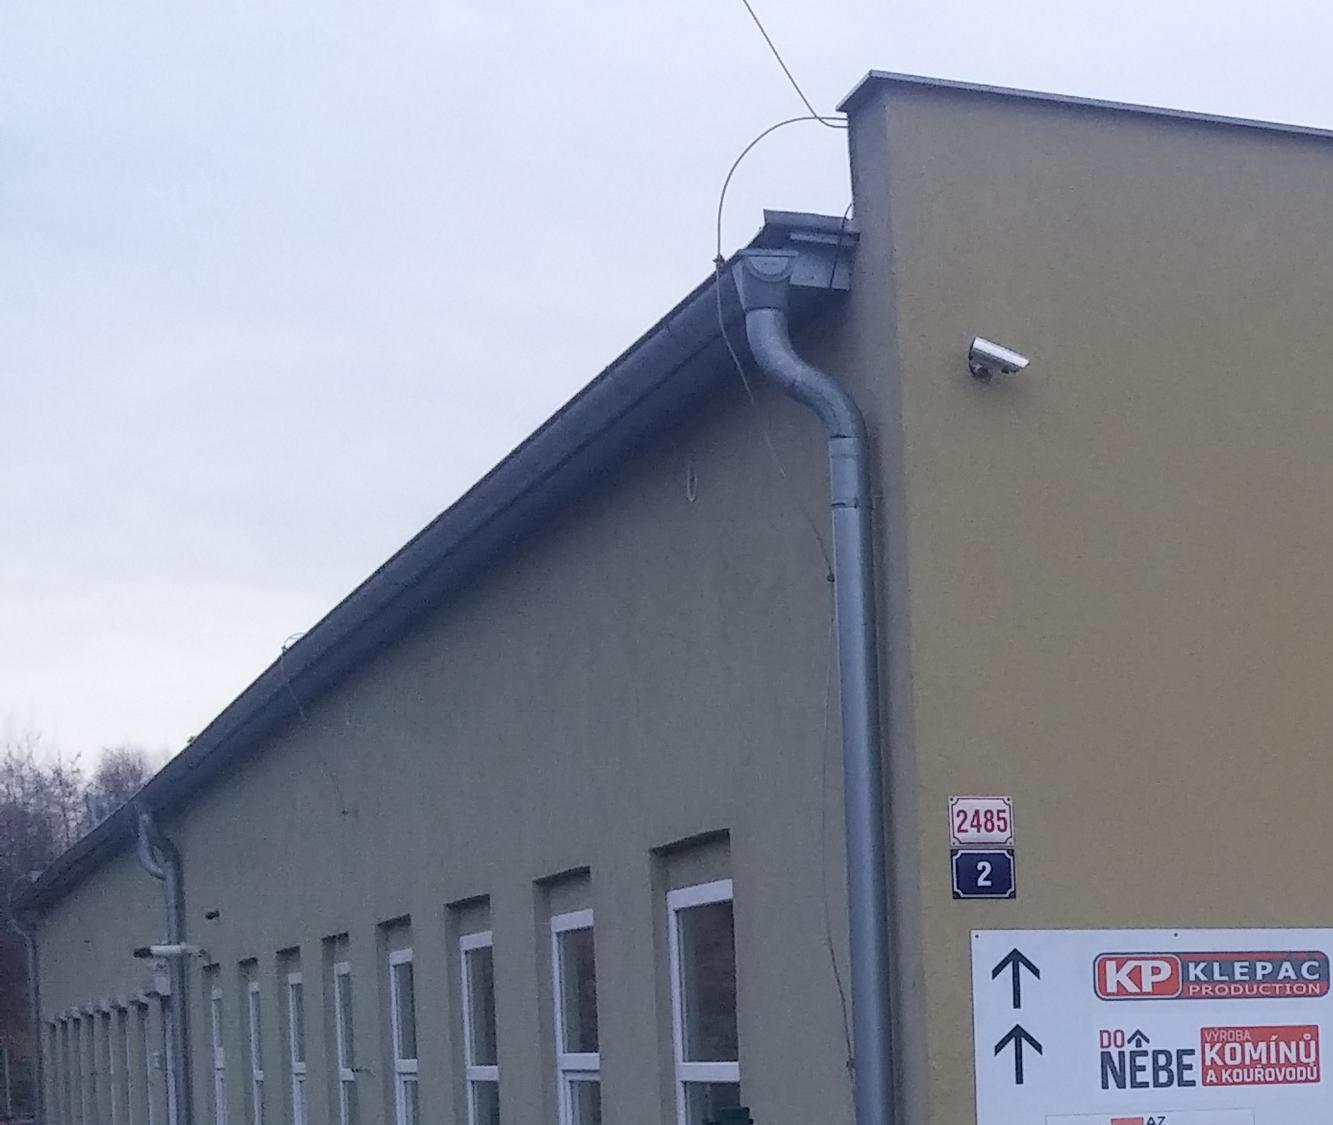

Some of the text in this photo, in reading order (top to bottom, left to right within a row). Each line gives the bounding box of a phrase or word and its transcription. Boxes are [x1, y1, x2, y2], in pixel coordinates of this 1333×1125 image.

[956, 809, 1008, 834] 2485
[976, 861, 992, 887] 2
[1105, 960, 1172, 994] KP
[1189, 982, 1321, 996] PRODUCTION
[1099, 1029, 1125, 1049] DO
[1204, 1028, 1252, 1042] VÝROBA
[1204, 1033, 1317, 1066] KOMÍNŮ
[1100, 1049, 1197, 1090] NEBE
[1206, 1064, 1318, 1084] A KOUŘOVODŮ
